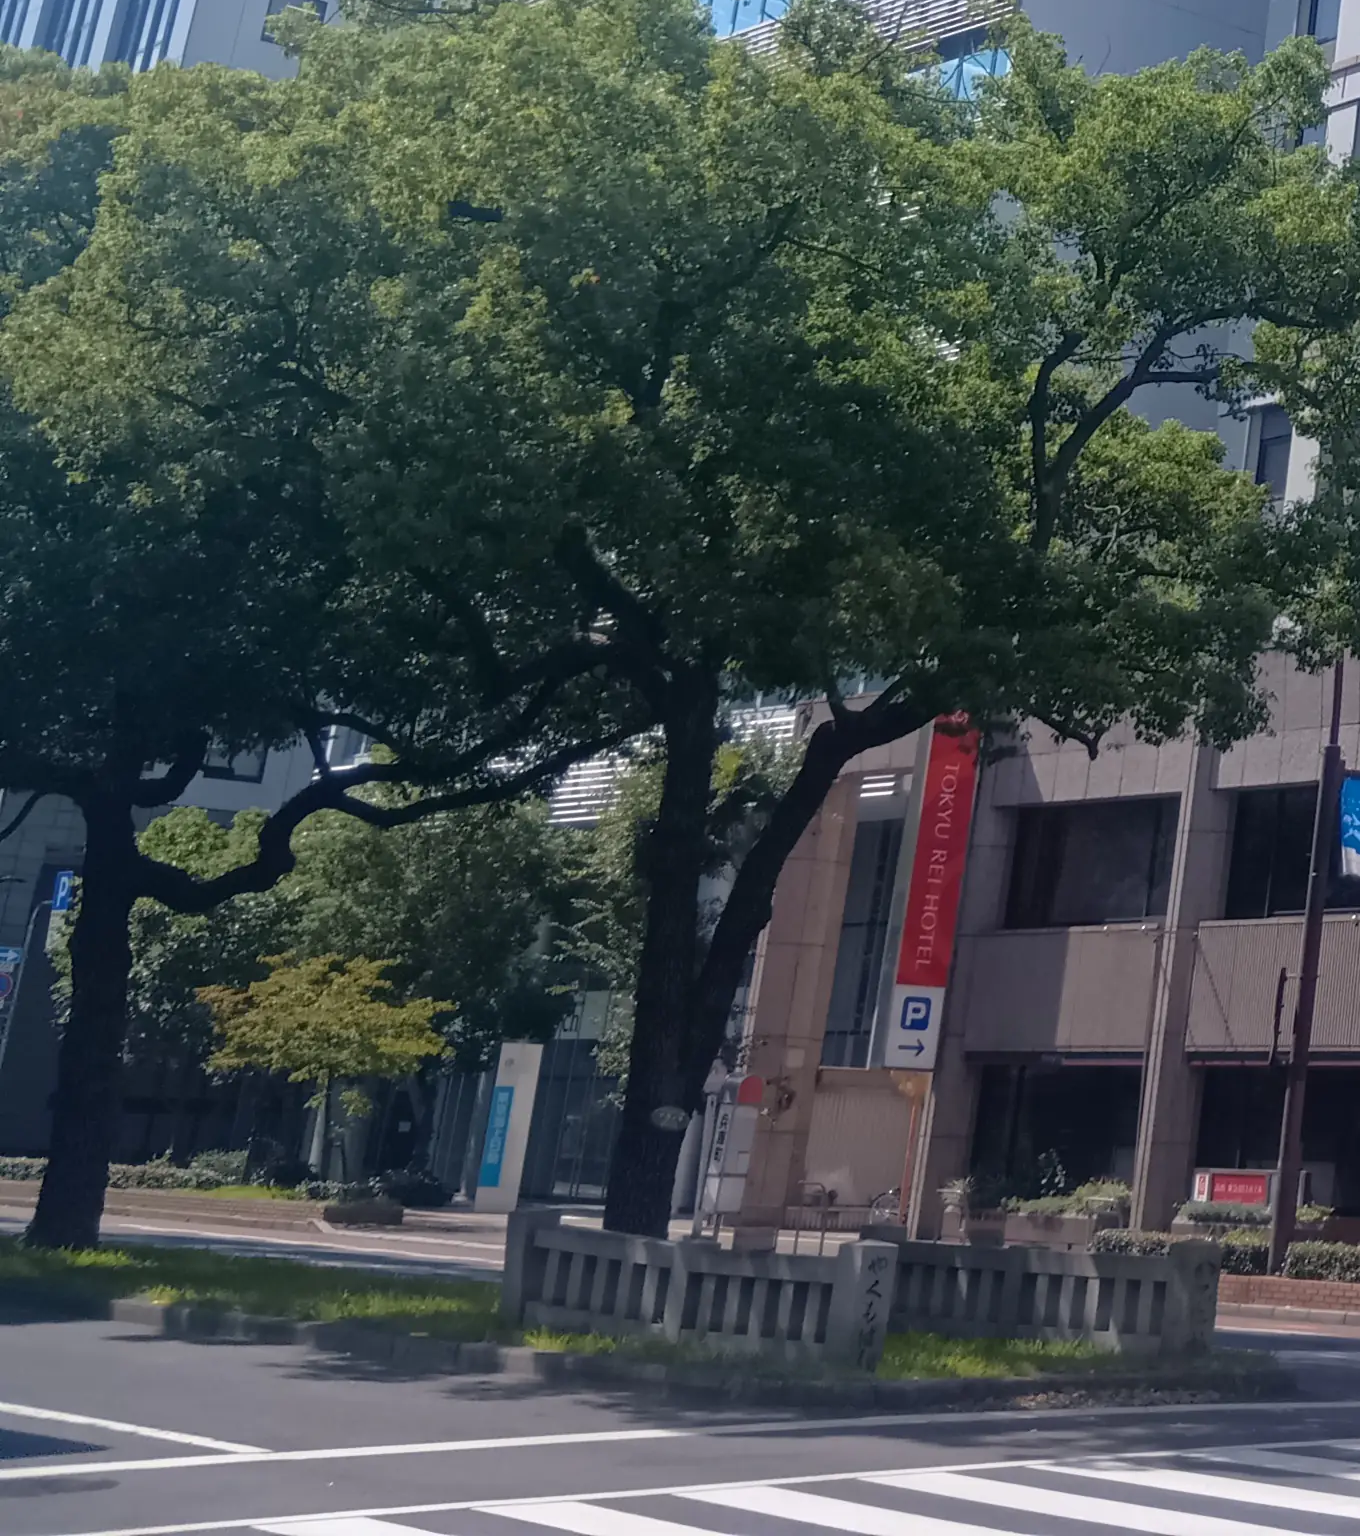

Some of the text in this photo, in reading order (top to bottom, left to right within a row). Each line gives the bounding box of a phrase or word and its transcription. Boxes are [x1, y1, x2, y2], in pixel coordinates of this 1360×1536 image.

[914, 762, 960, 972] TOKYU REI HOTEL
[56, 875, 70, 908] P
[907, 1002, 927, 1024] P
